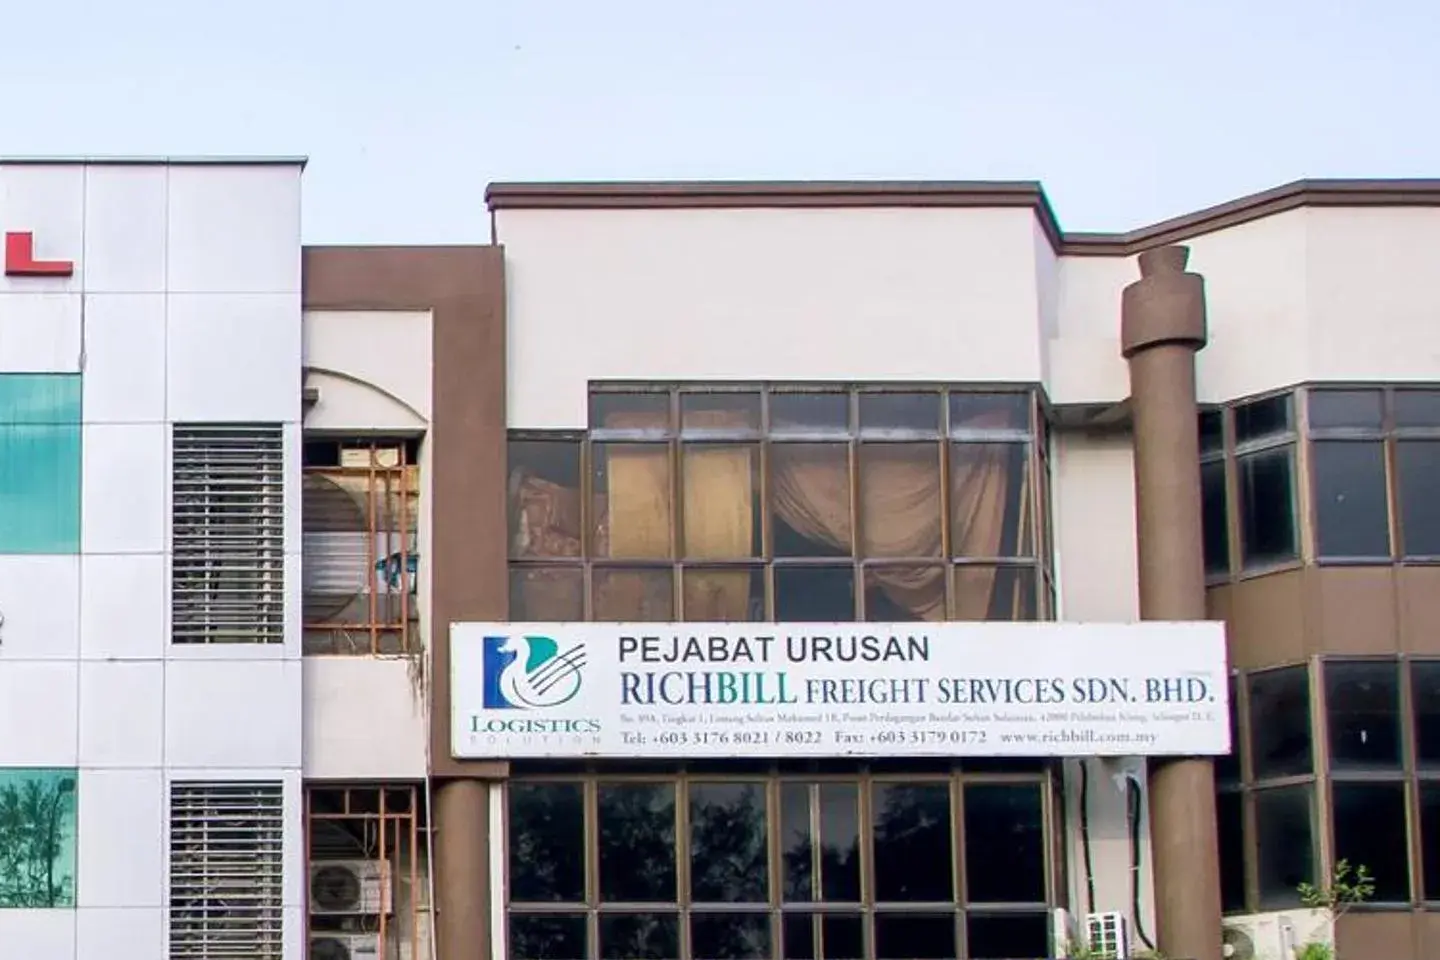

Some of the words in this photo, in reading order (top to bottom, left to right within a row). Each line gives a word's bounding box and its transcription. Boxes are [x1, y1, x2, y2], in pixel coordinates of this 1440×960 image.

[618, 636, 775, 662] PEJABAT
[786, 636, 929, 661] URUSAN
[620, 671, 798, 704] RICHBILL
[806, 678, 931, 704] FREIGHT
[937, 678, 1065, 704] SERVICES
[1072, 678, 1137, 703] SDN.
[1145, 678, 1215, 703] BHD.
[470, 716, 602, 733] LOGISTICS
[620, 731, 647, 744] Tel:
[653, 731, 688, 744] +603
[693, 731, 729, 744] 3176
[733, 731, 768, 744] 8021
[785, 731, 822, 744] 8022
[835, 731, 863, 743] Fax:
[870, 731, 905, 743] +603
[910, 731, 946, 743] 3179
[950, 731, 987, 743] 0172
[1001, 730, 1158, 745] www.richbill.com.my
